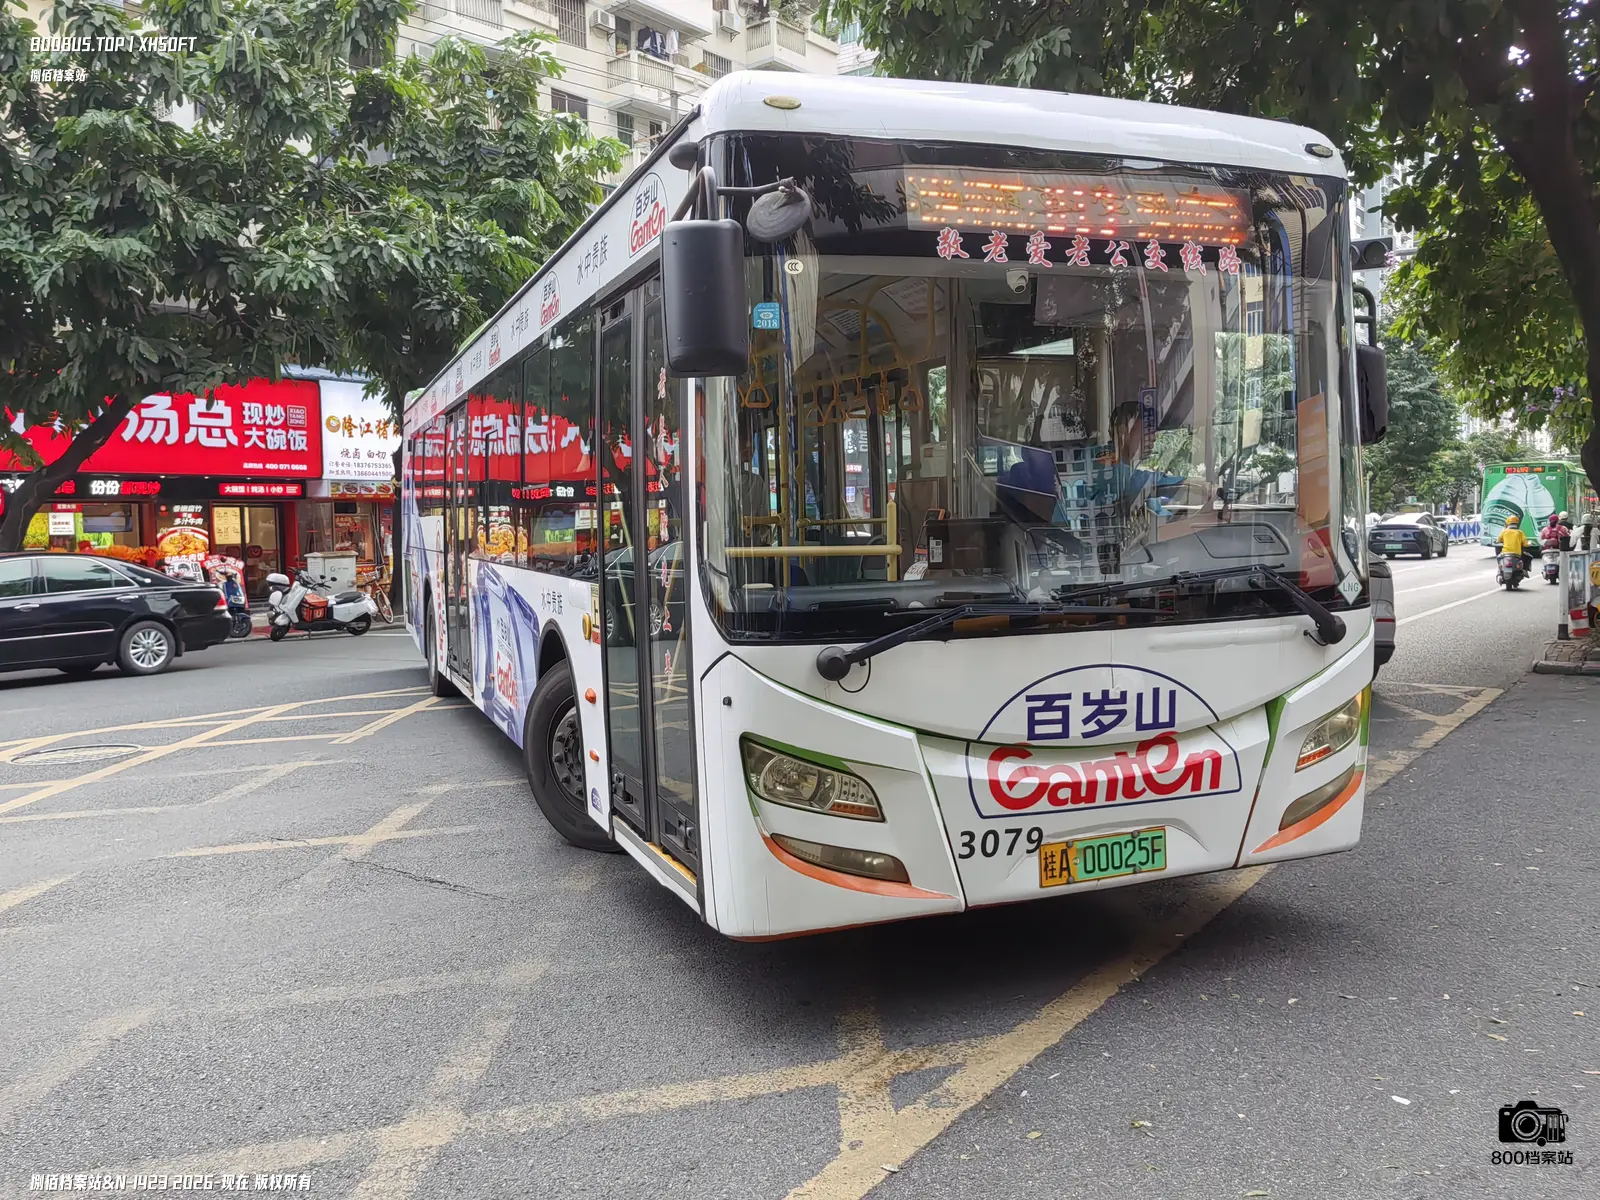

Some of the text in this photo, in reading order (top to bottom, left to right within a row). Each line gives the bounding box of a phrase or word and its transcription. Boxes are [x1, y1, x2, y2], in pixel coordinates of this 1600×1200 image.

[636, 180, 659, 219] 百岁山
[576, 232, 609, 286] 水中贵族
[936, 226, 1243, 276] 敬老爱老公交线路
[757, 319, 778, 328] 2018
[242, 402, 286, 426] 现炒
[244, 427, 308, 451] 大碗饭
[1343, 582, 1359, 592] LNG
[1025, 686, 1177, 741] 百岁山
[986, 731, 1222, 811] Ganten
[957, 826, 1044, 859] 3079
[1043, 835, 1163, 881] 桂A 00025F
